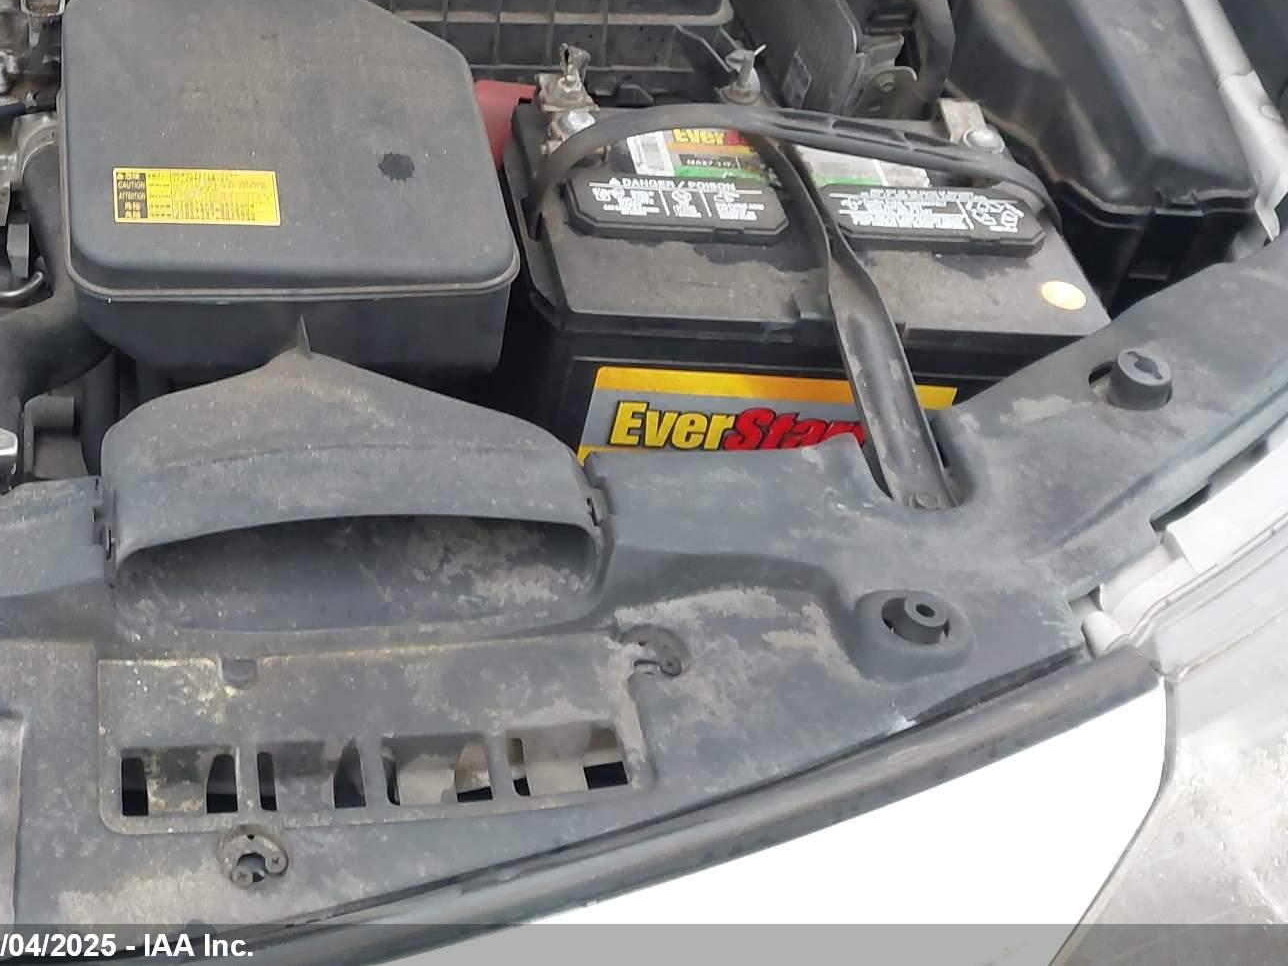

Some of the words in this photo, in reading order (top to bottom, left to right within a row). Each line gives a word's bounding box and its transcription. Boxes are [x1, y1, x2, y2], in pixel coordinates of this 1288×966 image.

[117, 180, 145, 189] CAUTION
[621, 177, 675, 190] DANGER
[687, 181, 736, 192] POISON
